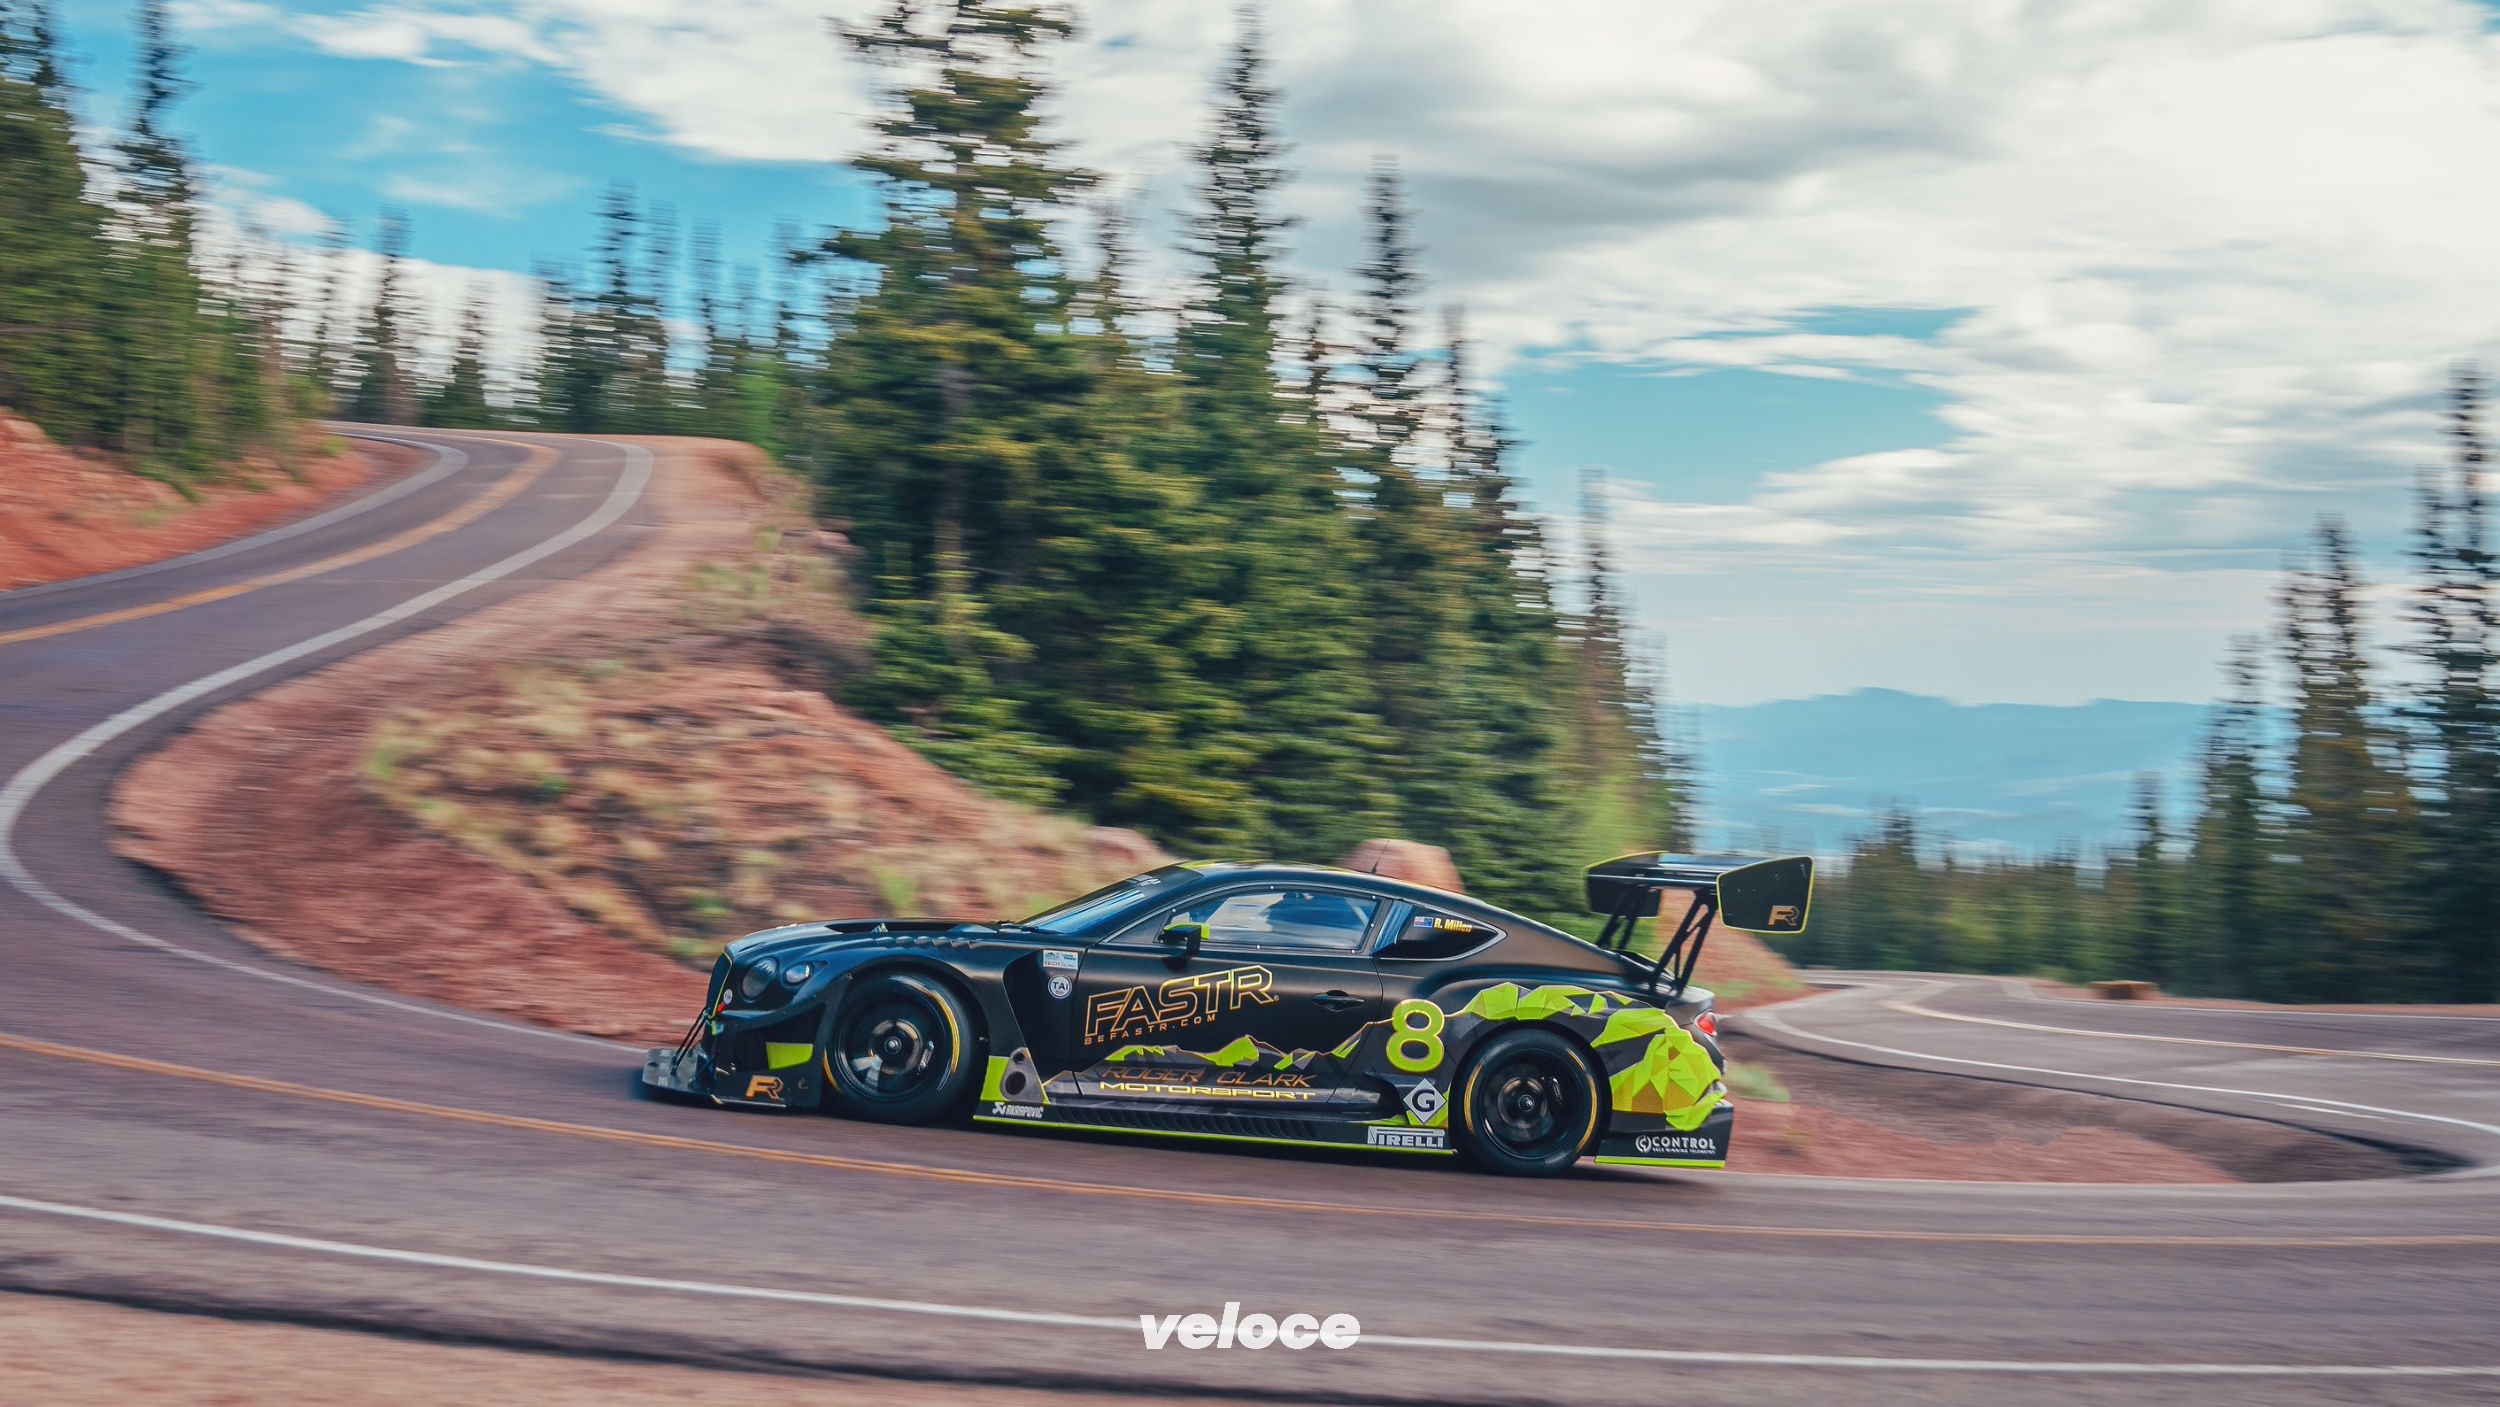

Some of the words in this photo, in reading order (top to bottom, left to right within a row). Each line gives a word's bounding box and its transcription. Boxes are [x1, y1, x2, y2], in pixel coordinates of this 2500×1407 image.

[1434, 917, 1443, 929] R.
[1052, 981, 1069, 991] TAI
[1084, 1013, 1216, 1046] BEFASTR.COM
[1386, 998, 1445, 1072] 8
[1101, 1066, 1205, 1083] ROGER
[1216, 1071, 1316, 1088] CLARK
[1100, 1081, 1316, 1100] MOTORSPORT
[1411, 1088, 1436, 1113] G
[1367, 1125, 1446, 1149] PIRELLI
[1652, 1136, 1716, 1149] CONTROL
